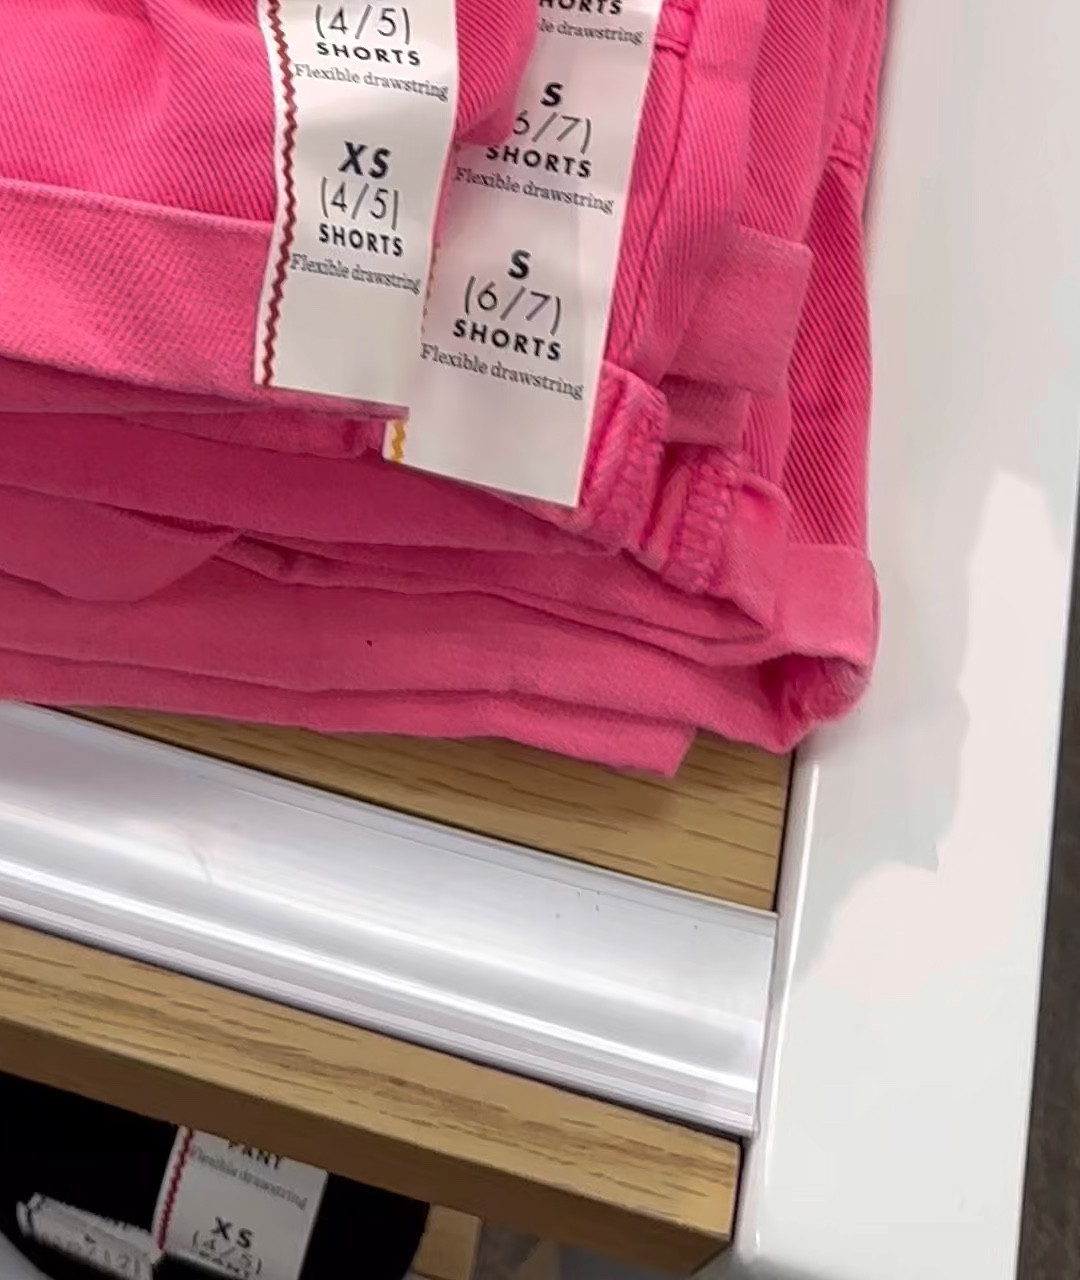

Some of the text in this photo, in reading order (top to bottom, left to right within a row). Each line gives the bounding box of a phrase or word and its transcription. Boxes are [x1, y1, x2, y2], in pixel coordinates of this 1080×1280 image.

[315, 4, 411, 45] (4/5)
[557, 20, 646, 46] drawstring
[316, 41, 421, 67] SHORTS
[294, 63, 449, 103] Flexible drawstring
[540, 82, 563, 107] S
[512, 111, 592, 155] 6/7)
[338, 141, 392, 180] XS
[486, 144, 592, 179] SHORTS
[320, 176, 400, 231] (4/5)
[454, 166, 615, 215] Flexible drawstring
[318, 223, 405, 258] SHORTS
[290, 253, 421, 296] Flexible drawstring
[508, 249, 532, 280] S
[464, 275, 561, 336] (6/7)
[453, 318, 561, 362] SHORTS
[421, 342, 585, 401] Flexible drawstring
[211, 1216, 255, 1249] XS
